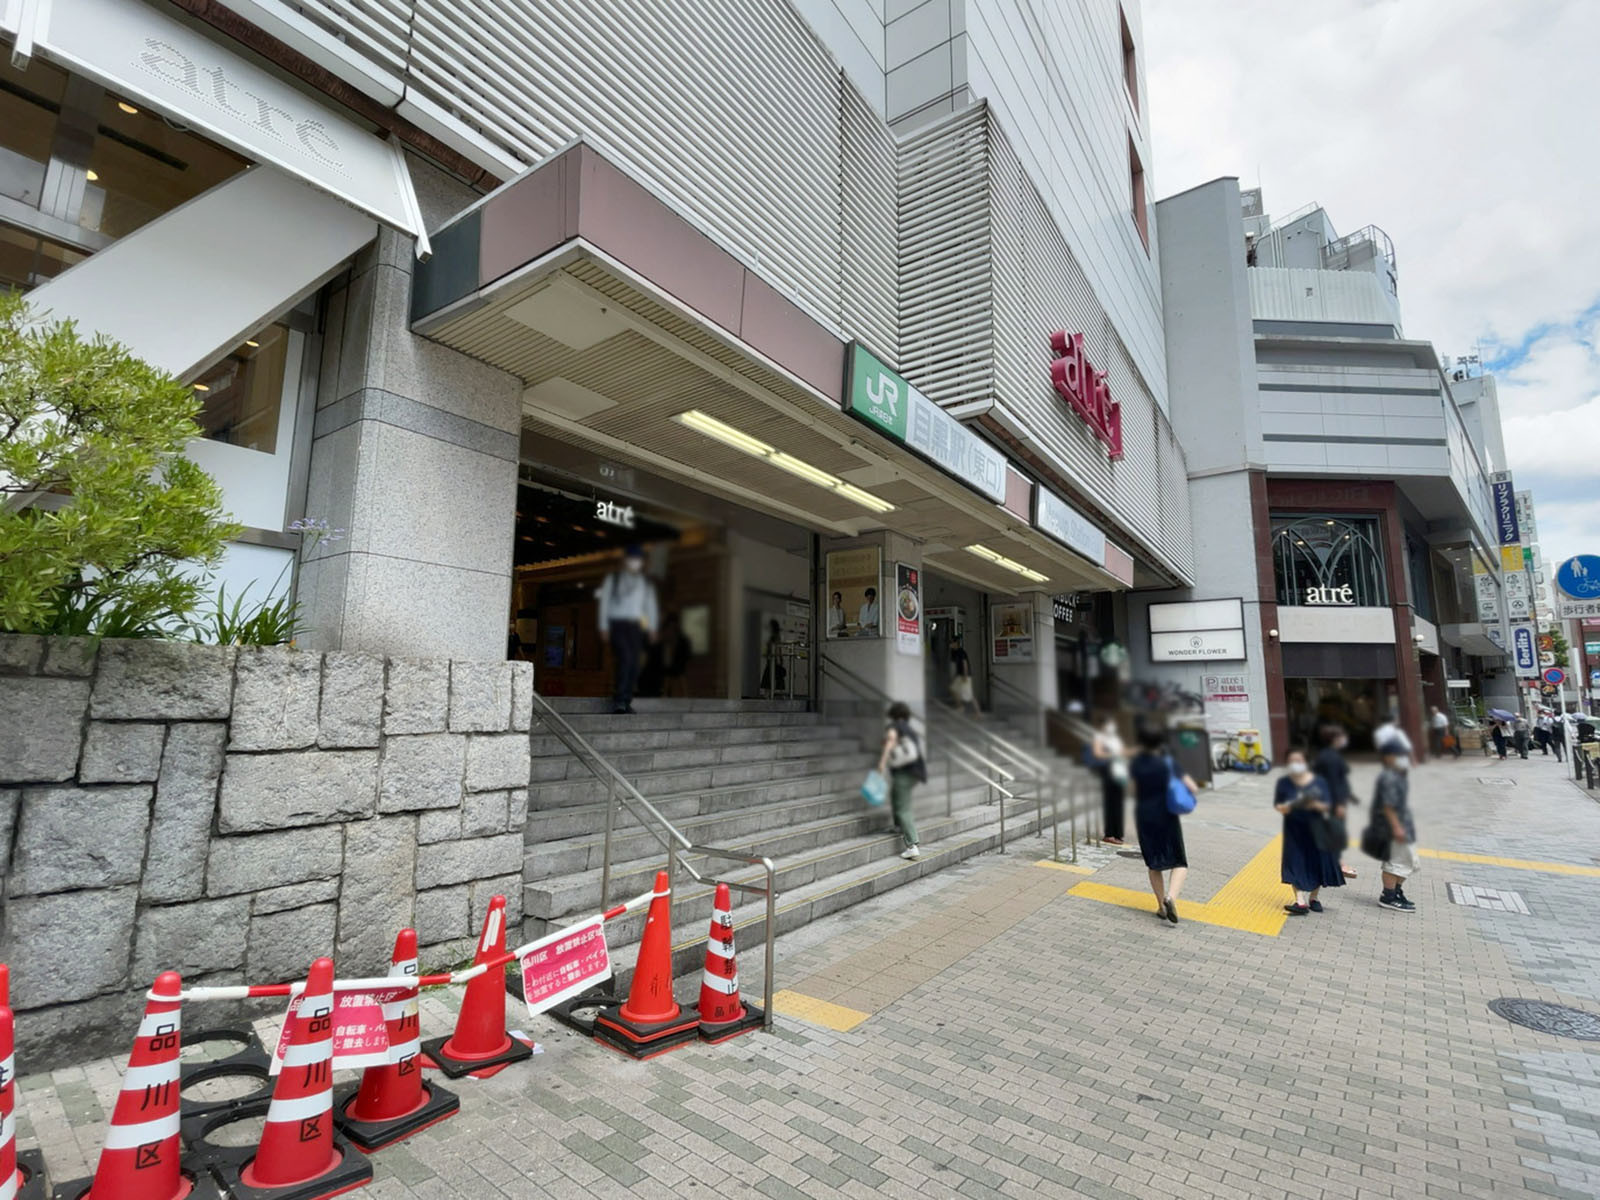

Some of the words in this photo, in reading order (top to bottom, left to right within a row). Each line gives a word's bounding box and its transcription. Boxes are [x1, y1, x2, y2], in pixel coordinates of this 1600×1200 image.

[866, 372, 898, 417] JR
[1305, 583, 1354, 605] atré
[1168, 648, 1198, 656] WONDER
[1198, 648, 1228, 656] FLOWER
[1517, 632, 1531, 666] Berlitz
